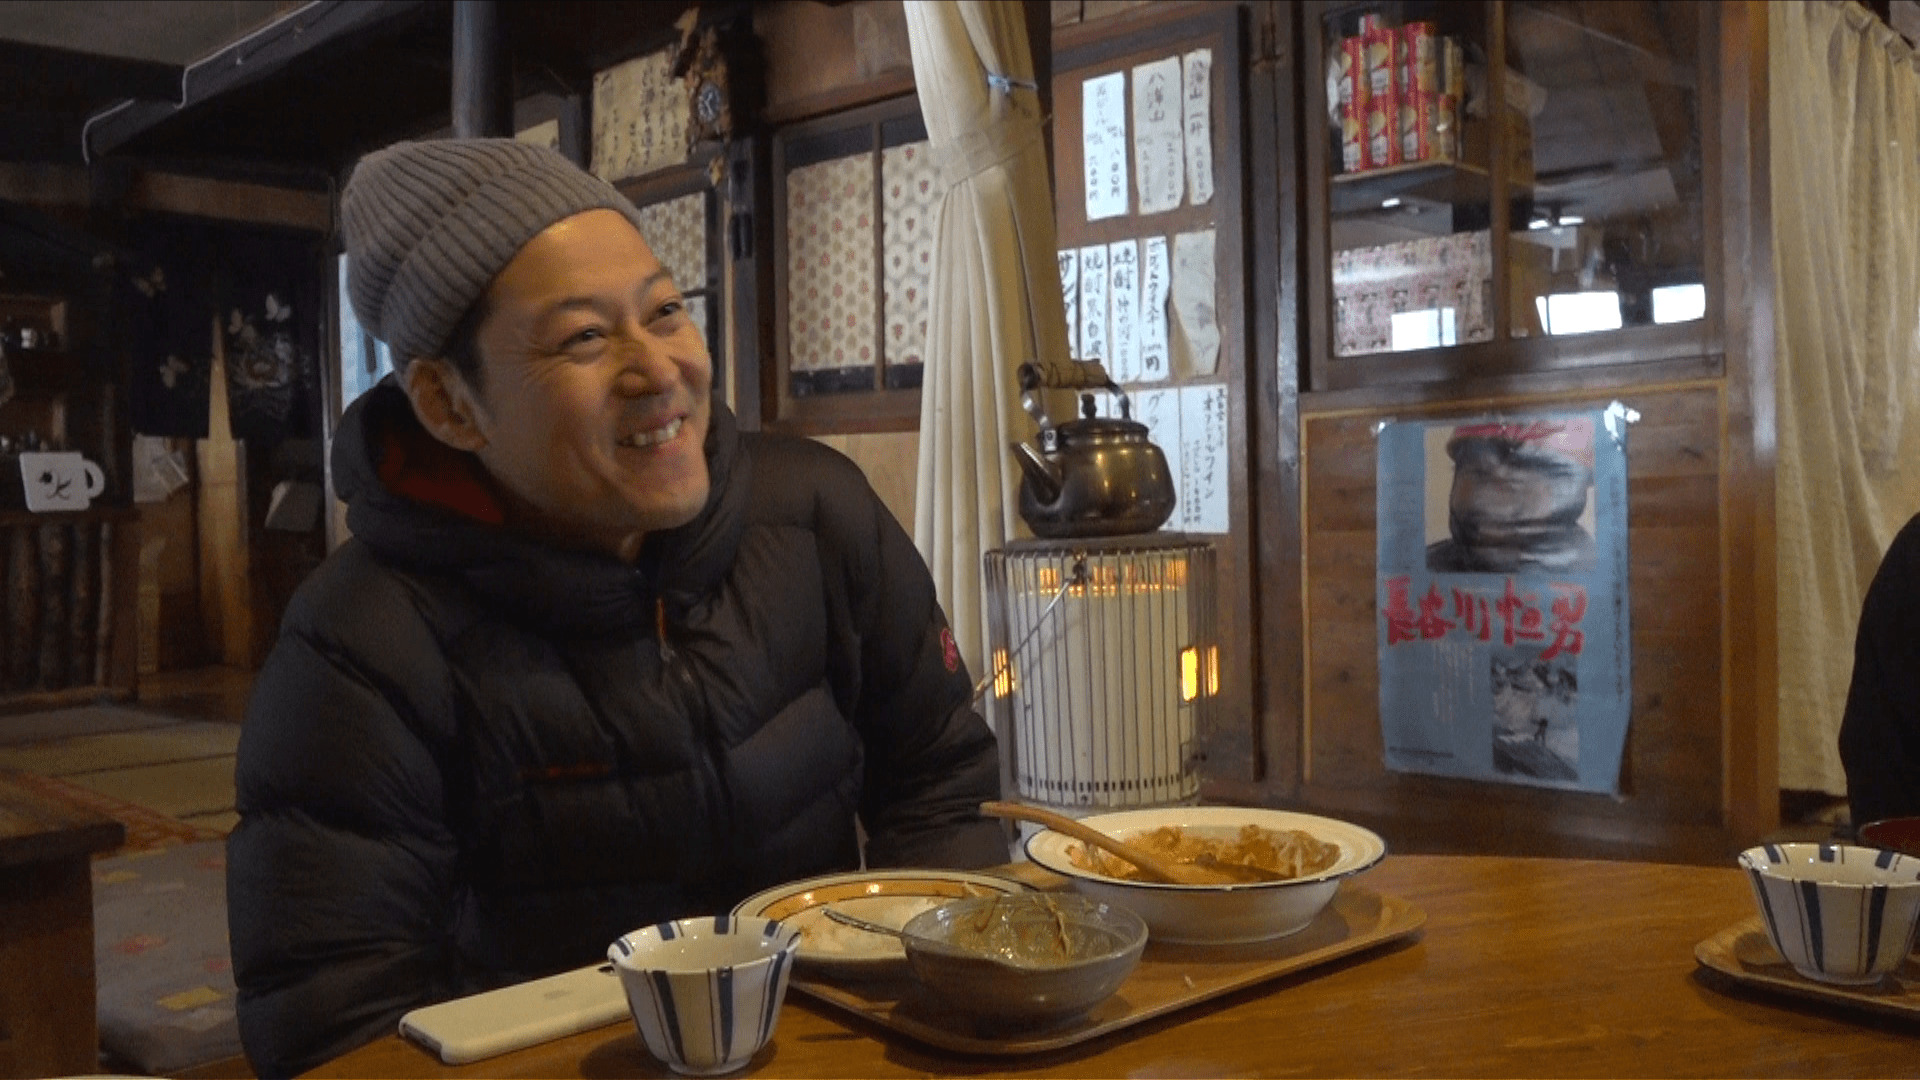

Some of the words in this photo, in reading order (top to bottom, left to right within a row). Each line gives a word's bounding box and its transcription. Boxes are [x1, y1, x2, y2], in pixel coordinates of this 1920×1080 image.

[1148, 72, 1165, 123] 八海山
[1383, 575, 1586, 662] 長谷川恒男
